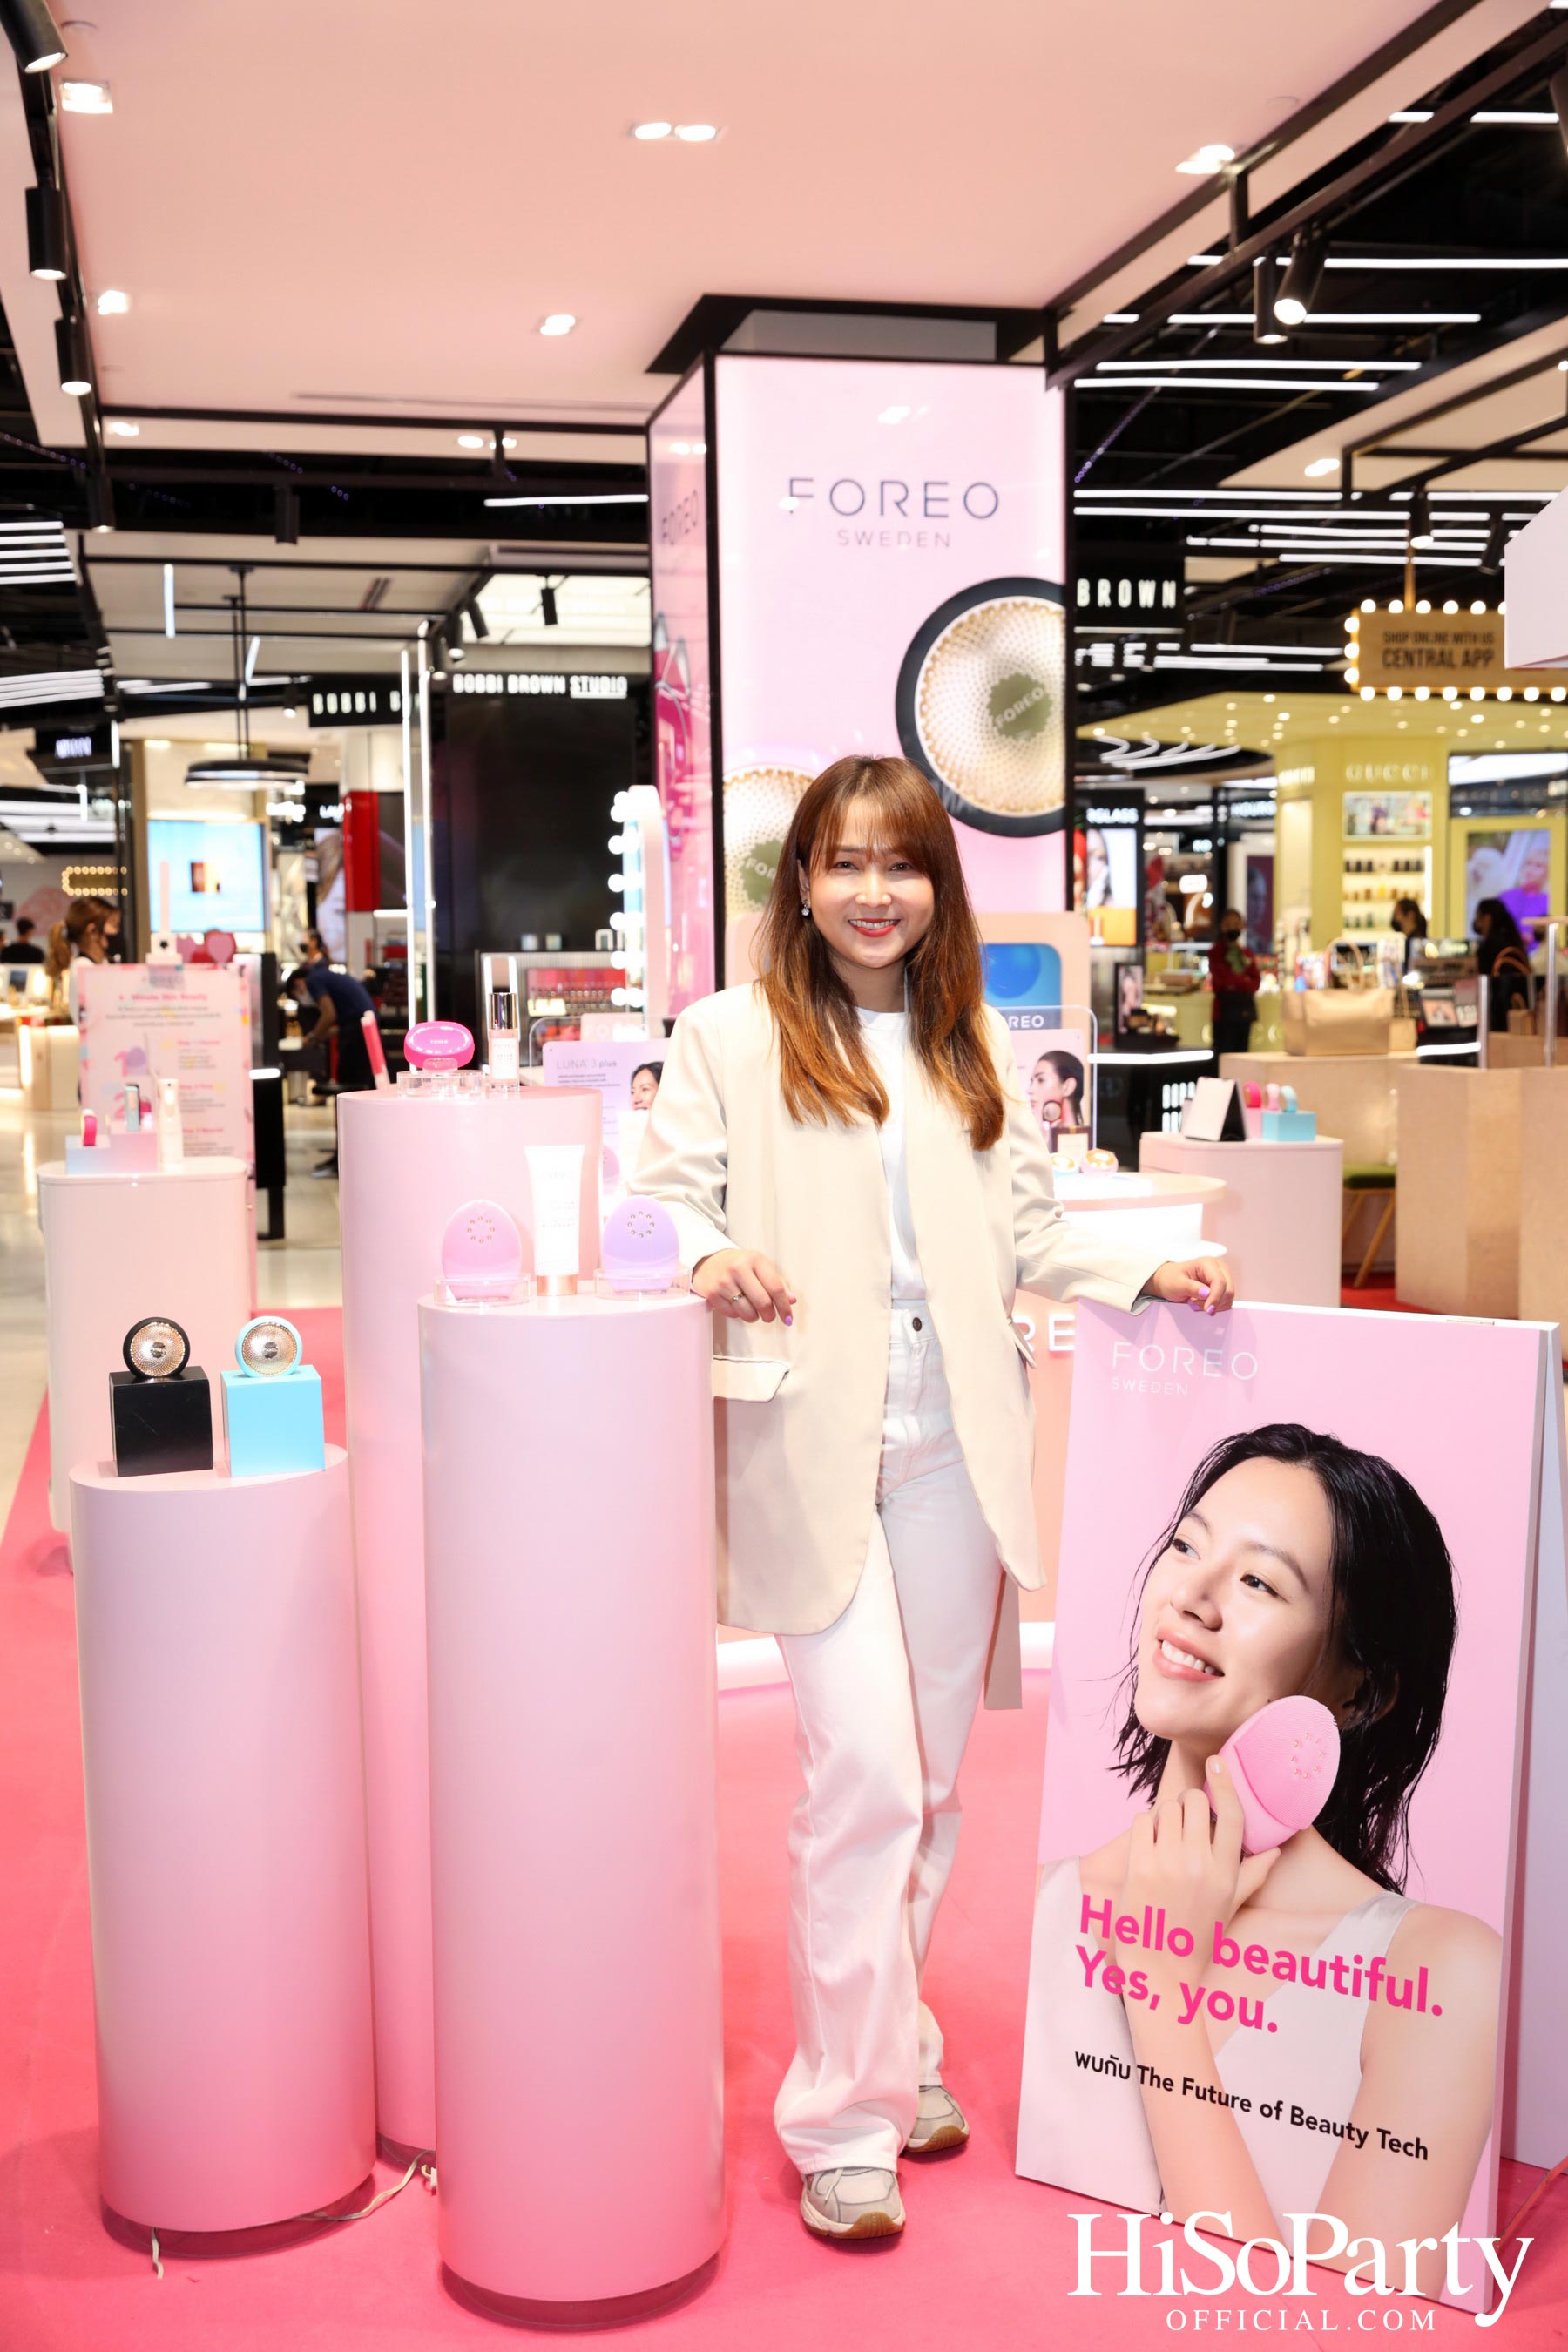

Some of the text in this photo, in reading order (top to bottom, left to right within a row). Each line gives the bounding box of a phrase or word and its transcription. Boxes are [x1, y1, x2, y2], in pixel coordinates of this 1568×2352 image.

[789, 477, 999, 520] FOREO
[837, 529, 950, 548] SWEDEN
[1077, 578, 1177, 608] BROWN
[1382, 647, 1495, 669] CENTRAL APP
[452, 673, 628, 697] BOBBI BROWN STUDIO
[1345, 764, 1429, 781] GUCCI
[1112, 1341, 1259, 1381] FOREO
[1111, 1376, 1189, 1396] SWEDEN
[1079, 1894, 1443, 2017] Hello beautiful.
[1076, 1945, 1279, 2033] Yes, you.
[1074, 2051, 1429, 2160] พบกับ The Future of Beauty Tech
